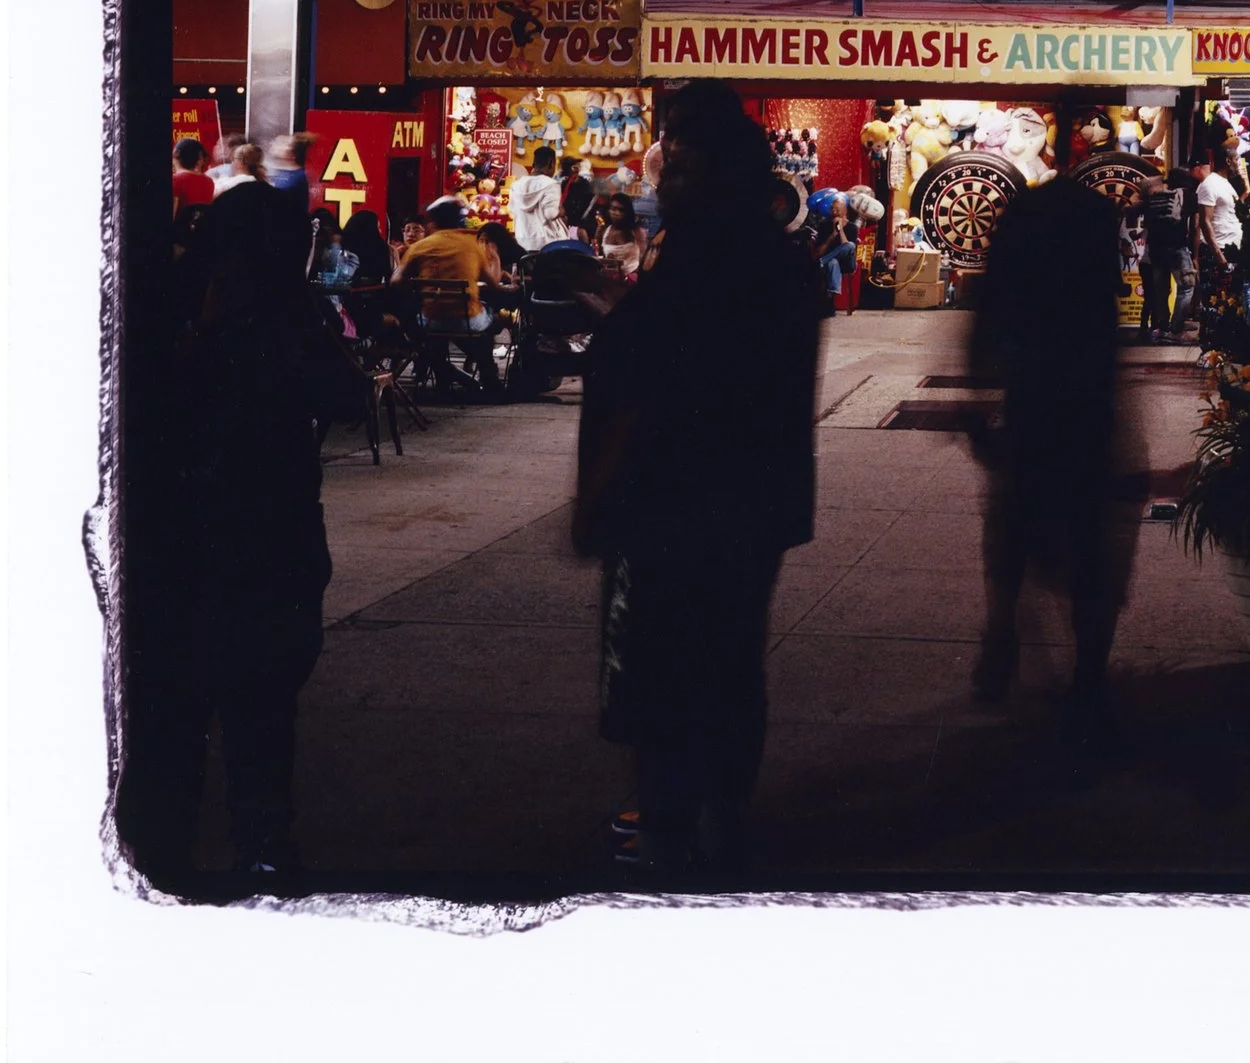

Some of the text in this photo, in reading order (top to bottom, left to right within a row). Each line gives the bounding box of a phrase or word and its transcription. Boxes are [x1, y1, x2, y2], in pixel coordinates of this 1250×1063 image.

[416, 0, 621, 23] RING MY NECK
[415, 24, 638, 67] RING TOSS
[650, 26, 1186, 73] HAMMER SMASH & ARCHERY
[183, 109, 198, 123] roll
[391, 121, 425, 148] ATM
[961, 169, 972, 177] 20
[938, 179, 947, 188] 12
[925, 204, 934, 212] 14
